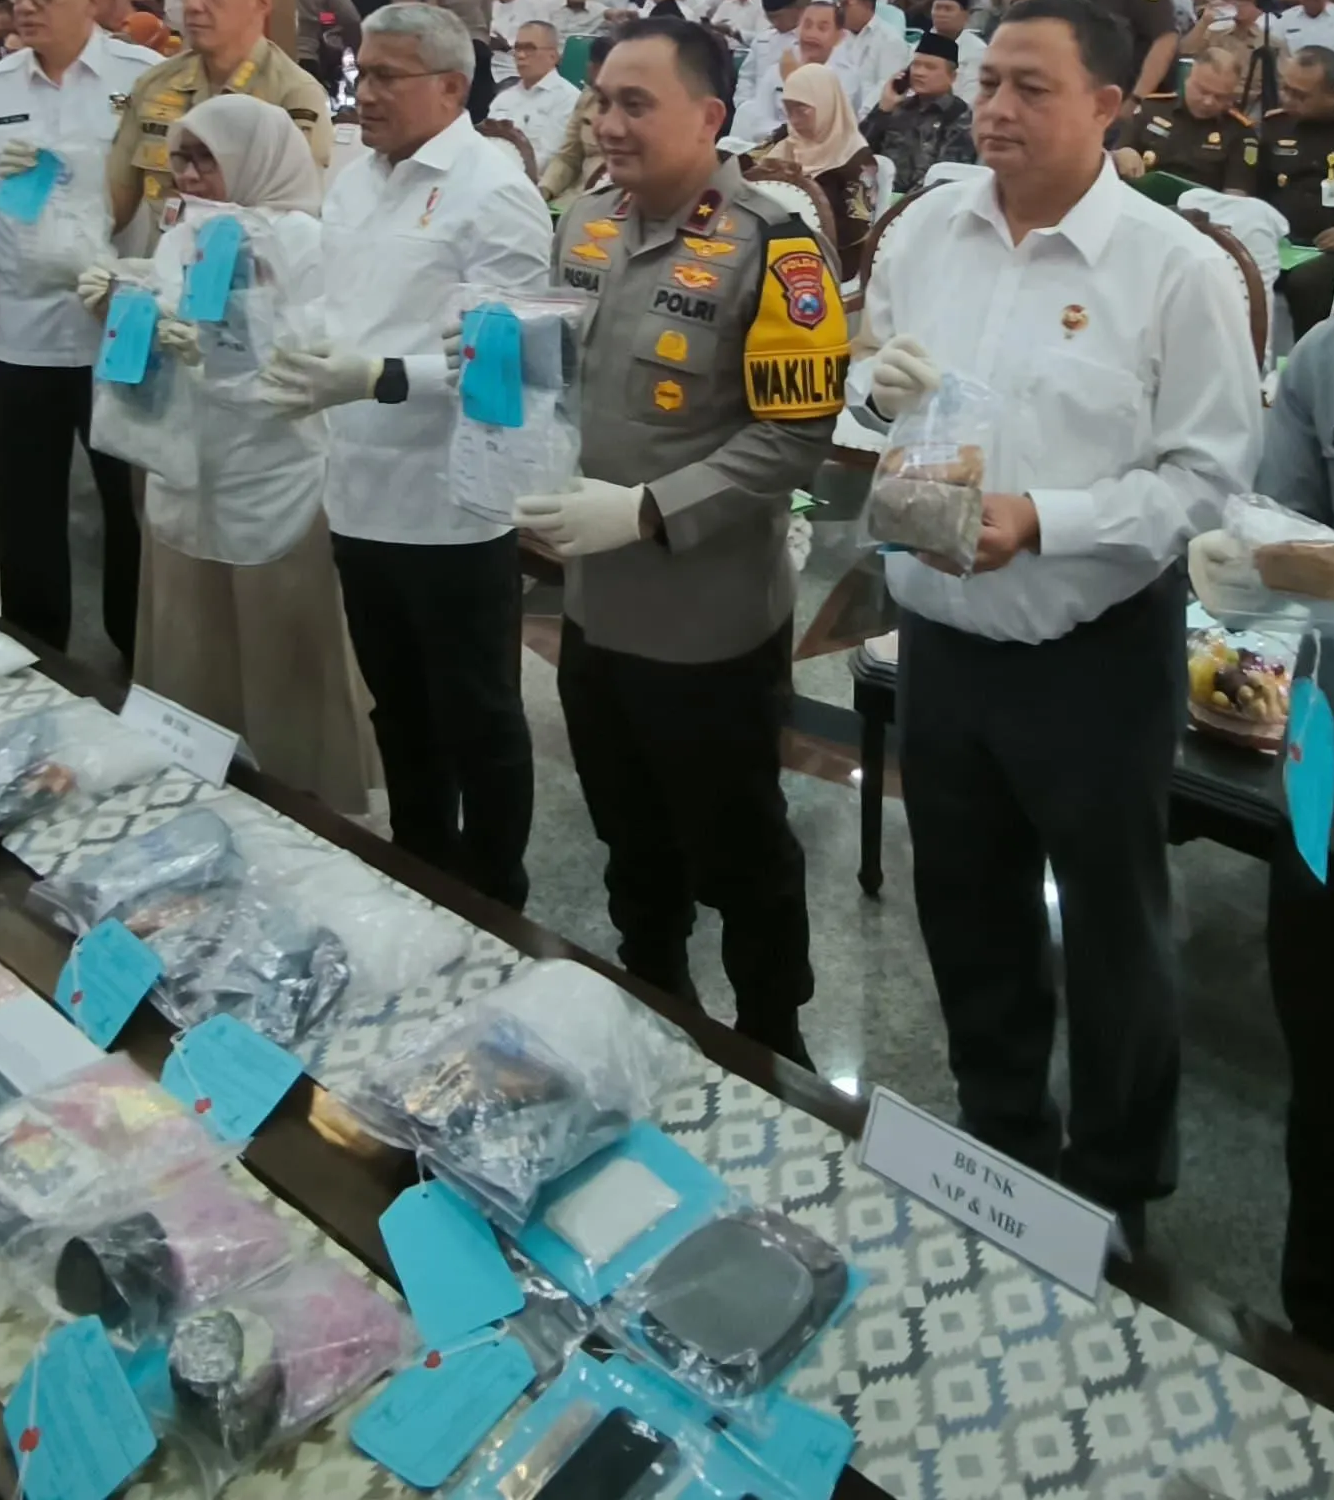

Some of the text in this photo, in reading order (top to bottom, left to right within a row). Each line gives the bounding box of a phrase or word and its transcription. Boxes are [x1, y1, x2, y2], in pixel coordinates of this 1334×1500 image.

[653, 290, 717, 322] POLRI
[749, 357, 823, 406] WAKIL
[953, 1151, 1019, 1199] BB TSK
[968, 1196, 981, 1216] &
